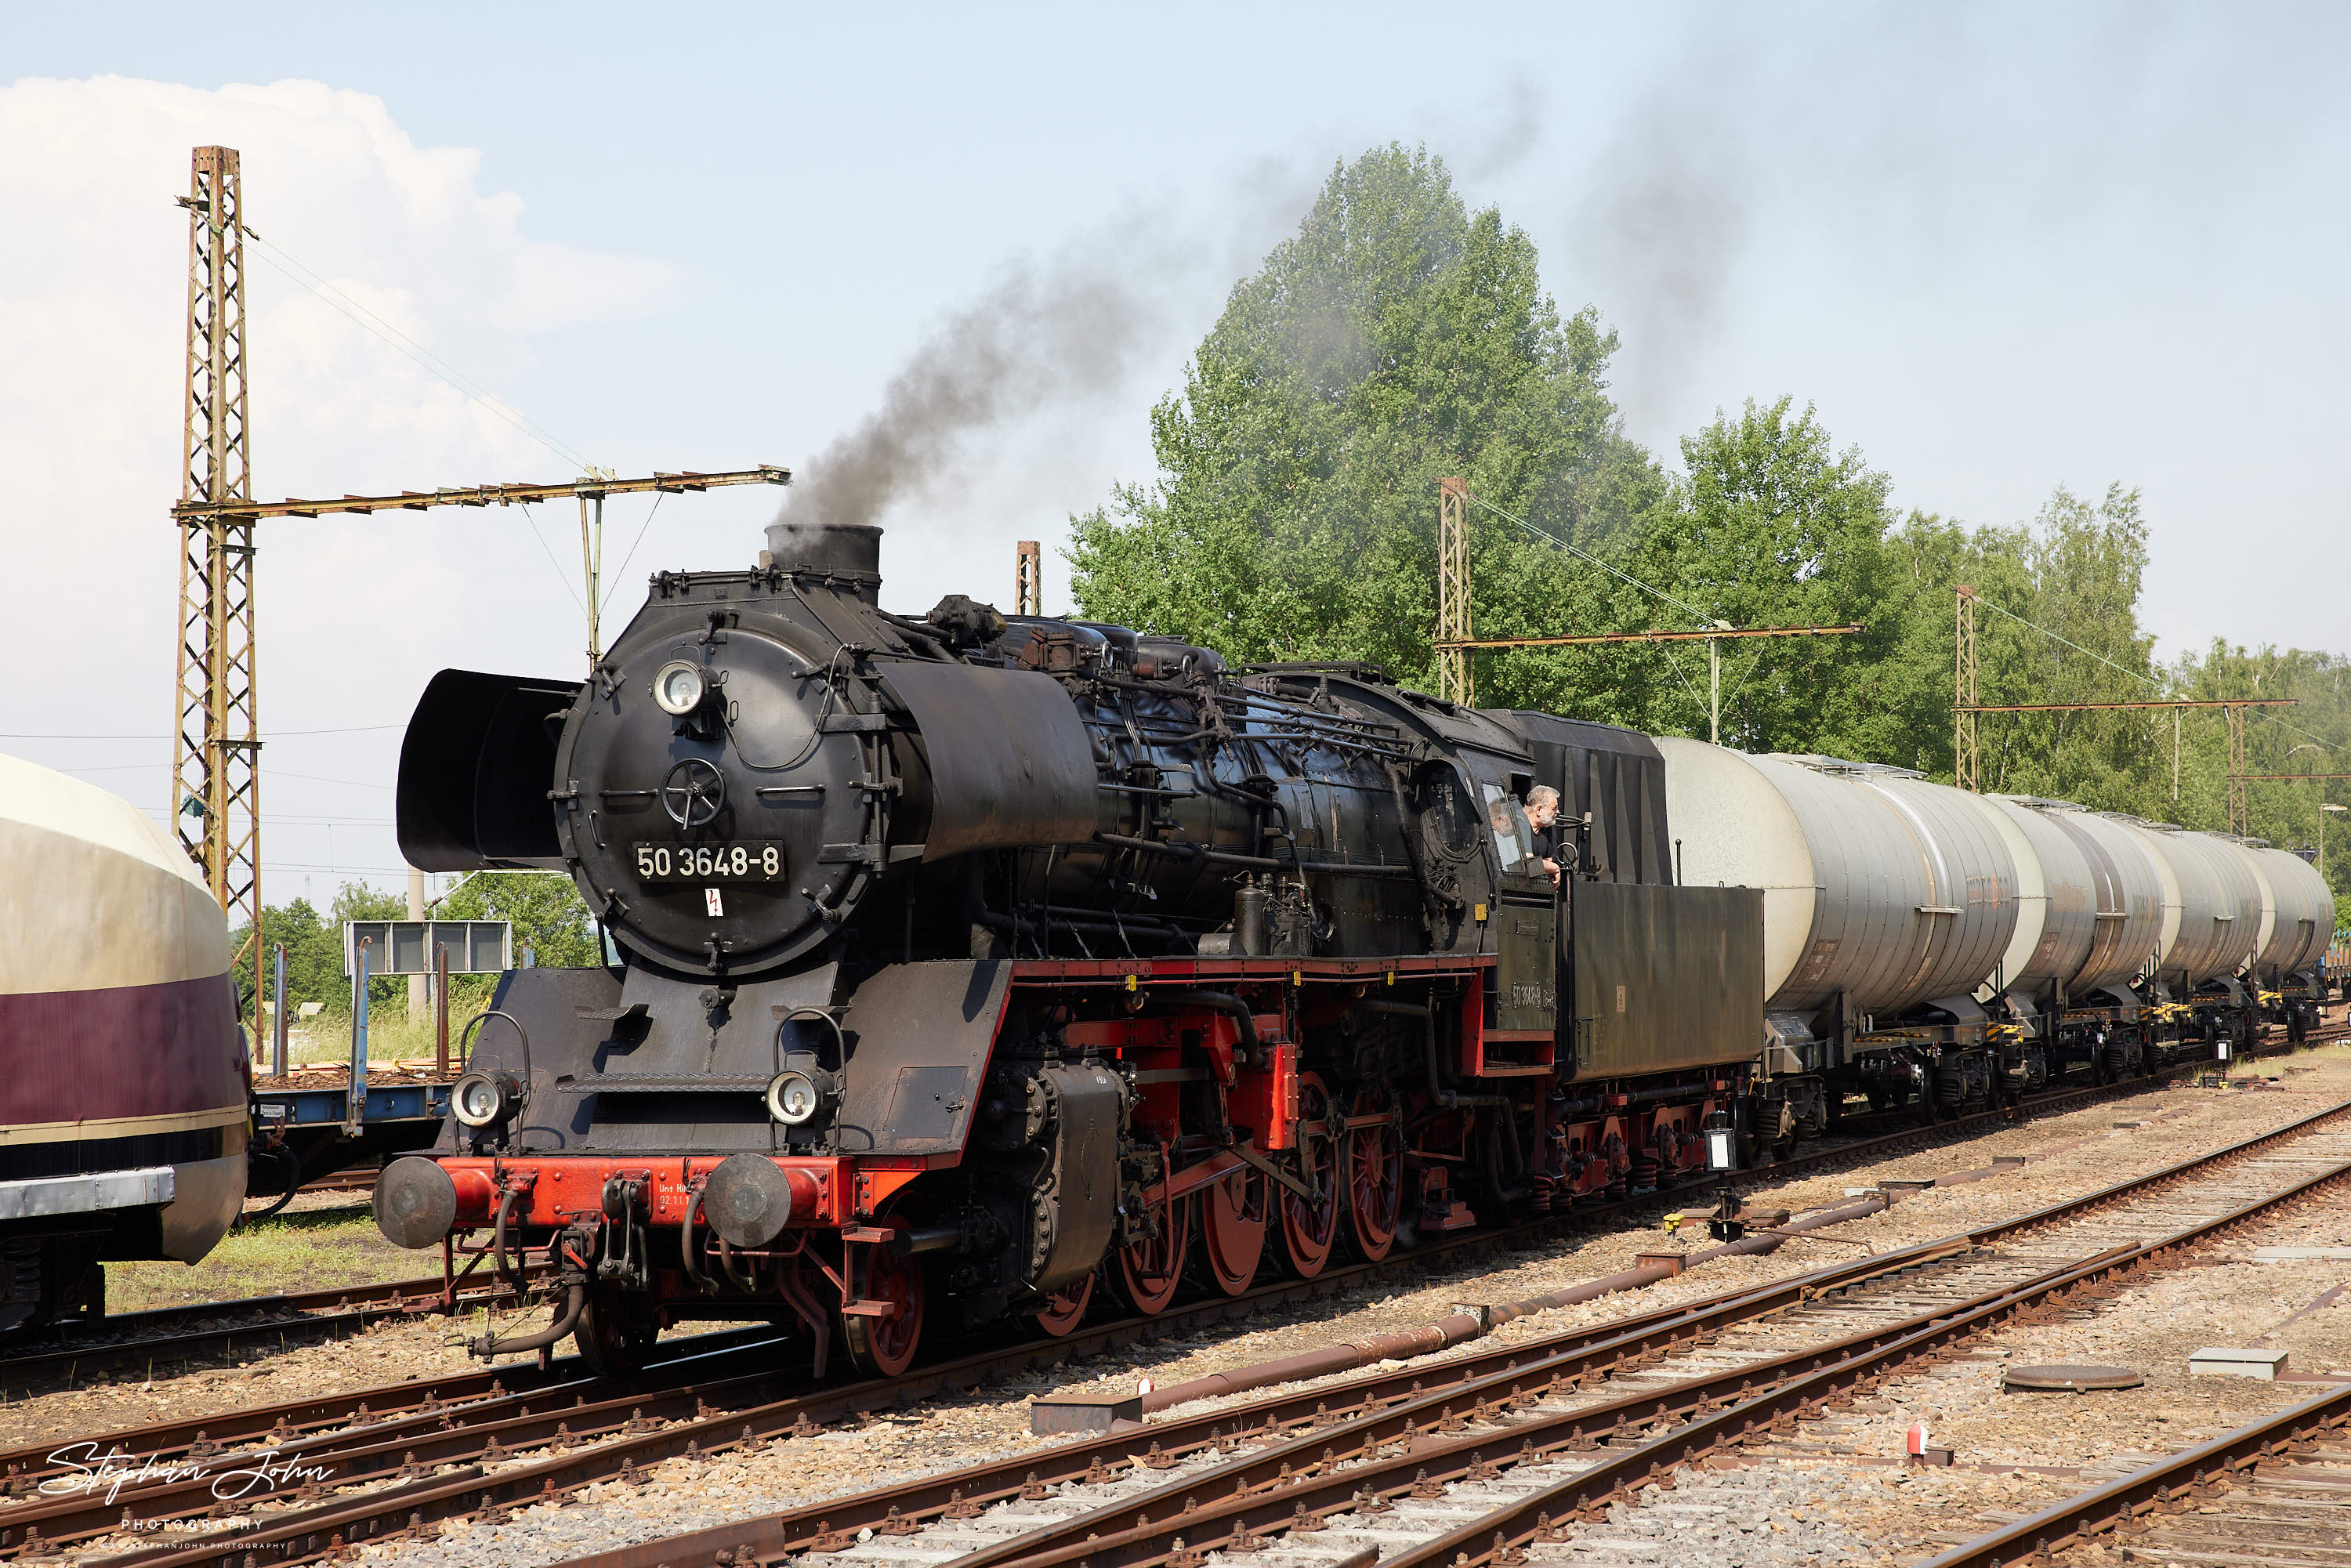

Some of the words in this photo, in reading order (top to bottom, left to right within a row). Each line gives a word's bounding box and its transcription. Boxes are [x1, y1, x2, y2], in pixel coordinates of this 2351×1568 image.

[637, 847, 672, 877] 50
[679, 846, 780, 877] 3648-8
[1512, 985, 1520, 1006] 50
[1521, 985, 1541, 1006] 3648-8
[659, 1183, 674, 1193] Unt
